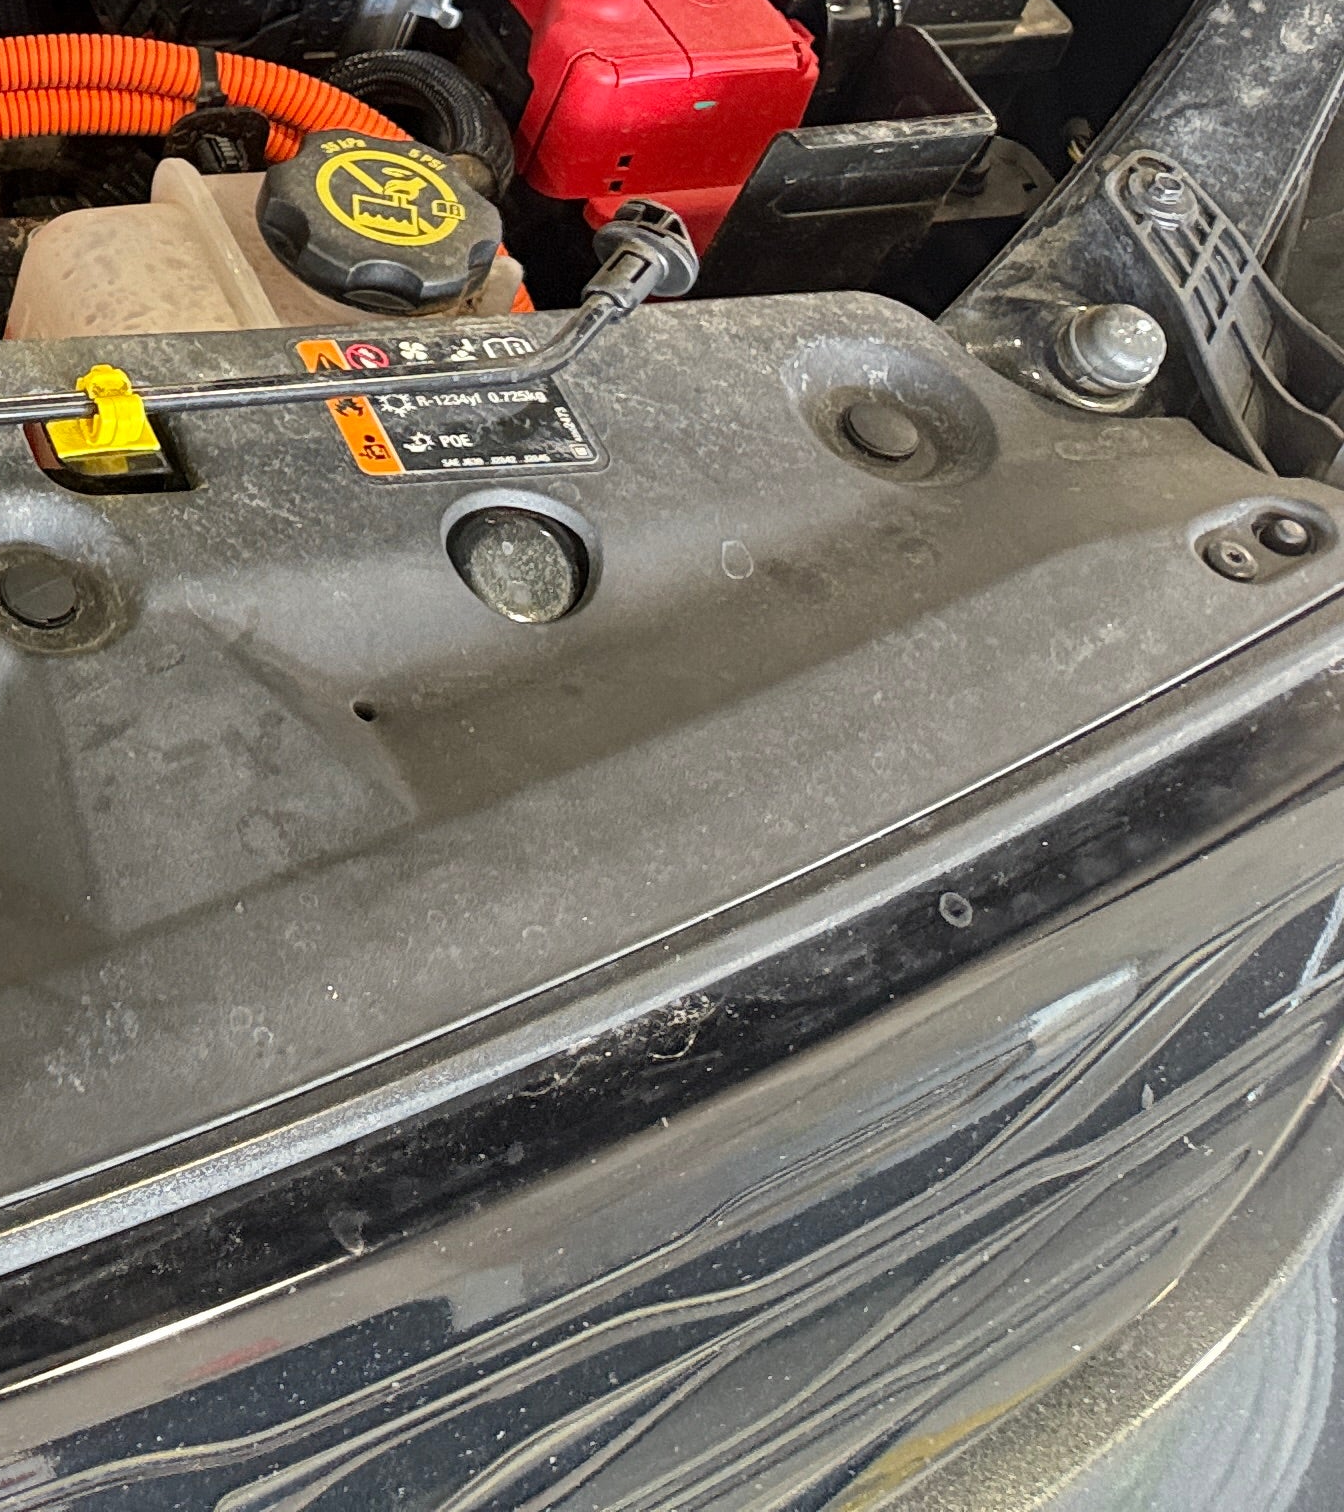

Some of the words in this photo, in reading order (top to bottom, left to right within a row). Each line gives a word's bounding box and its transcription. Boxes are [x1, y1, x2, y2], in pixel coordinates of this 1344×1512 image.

[320, 141, 341, 154] 35
[337, 137, 367, 149] kPa
[408, 148, 421, 158] 5
[420, 154, 448, 171] PSI
[415, 391, 483, 407] R-1234yf
[487, 389, 548, 405] 0.725kg
[438, 433, 474, 449] POE
